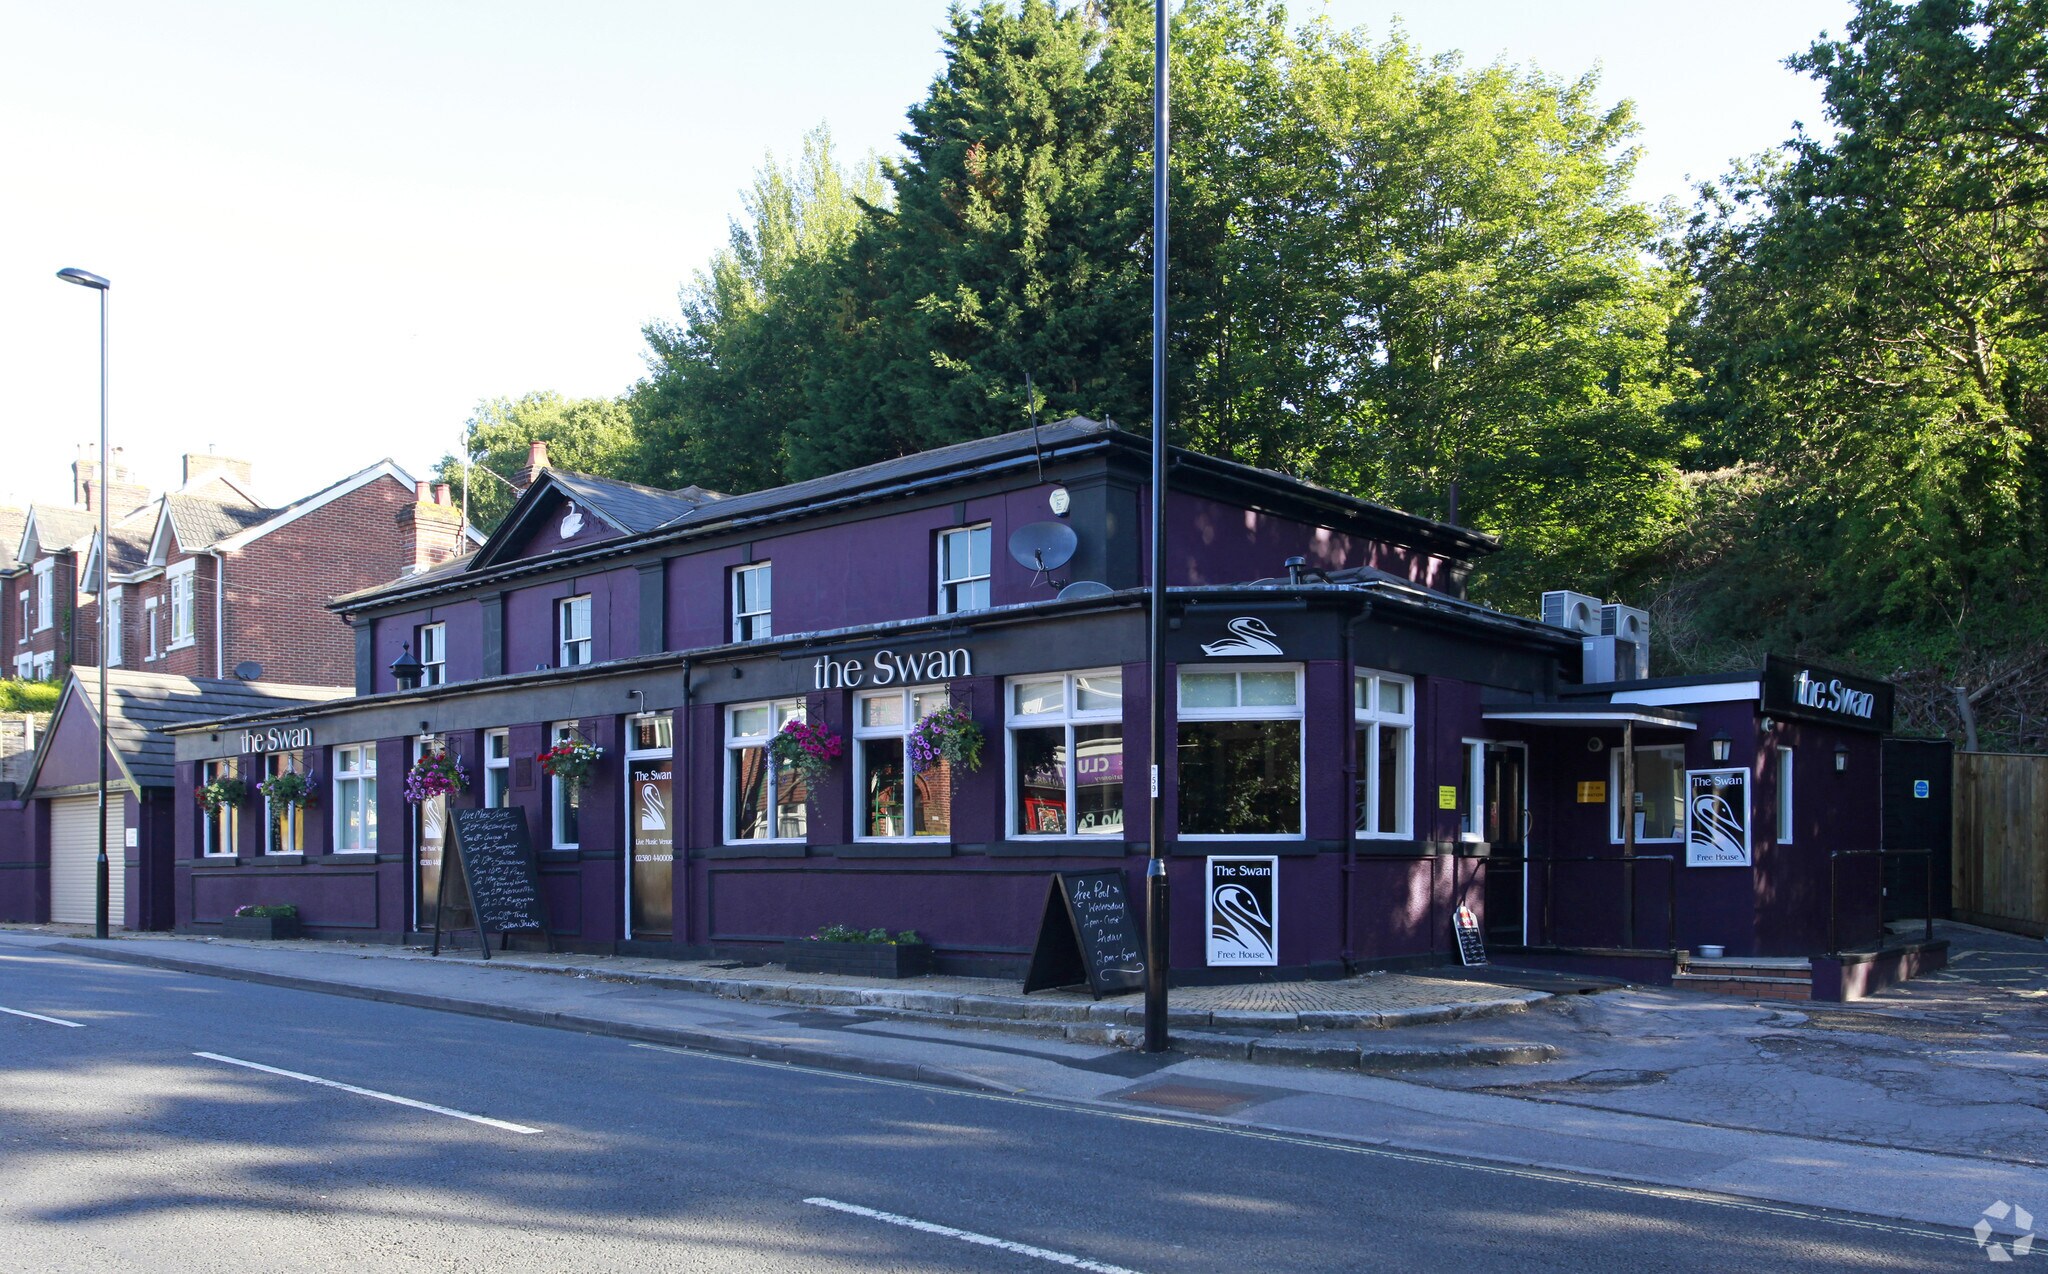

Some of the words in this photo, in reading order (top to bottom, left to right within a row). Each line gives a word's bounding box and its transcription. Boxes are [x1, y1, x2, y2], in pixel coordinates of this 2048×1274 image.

[814, 655, 862, 689] the
[873, 648, 972, 684] Swan
[1796, 670, 1826, 708] the
[1828, 679, 1874, 719] Swan
[241, 729, 264, 753] the
[267, 727, 312, 751] Swan
[635, 770, 649, 781] The
[651, 770, 672, 781] Swan
[1692, 777, 1711, 786] The
[1714, 776, 1743, 786] Swan
[658, 838, 673, 846] Venue
[1715, 853, 1739, 861] House
[1214, 865, 1236, 876] The
[1239, 865, 1271, 876] Swan
[1094, 880, 1110, 898] Pool
[1217, 951, 1236, 959] Free
[1238, 951, 1265, 959] House
